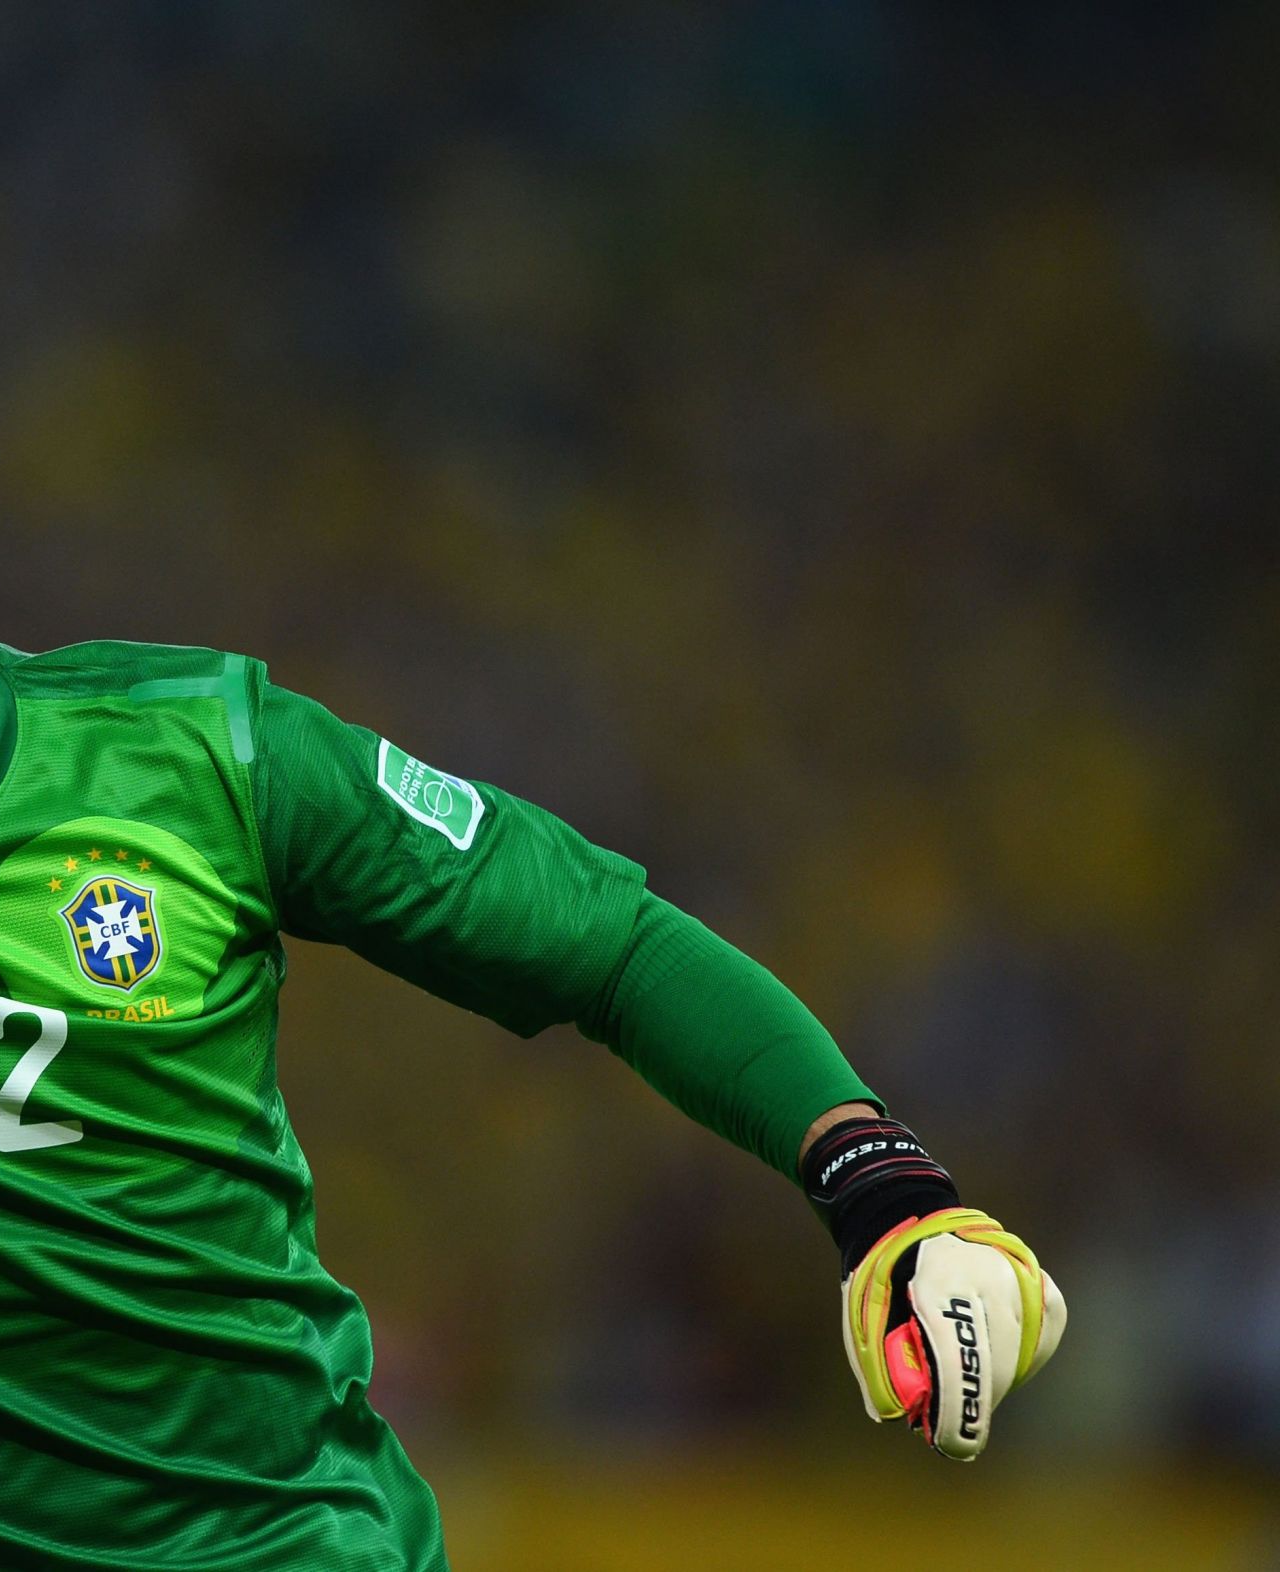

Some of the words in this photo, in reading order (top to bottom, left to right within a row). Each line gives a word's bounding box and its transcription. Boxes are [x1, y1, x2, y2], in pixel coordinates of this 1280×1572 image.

[407, 778, 422, 805] FOR
[100, 920, 130, 939] CBF
[894, 1141, 929, 1158] LIO
[821, 1141, 887, 1186] CESAR
[942, 1298, 981, 1441] reusch
